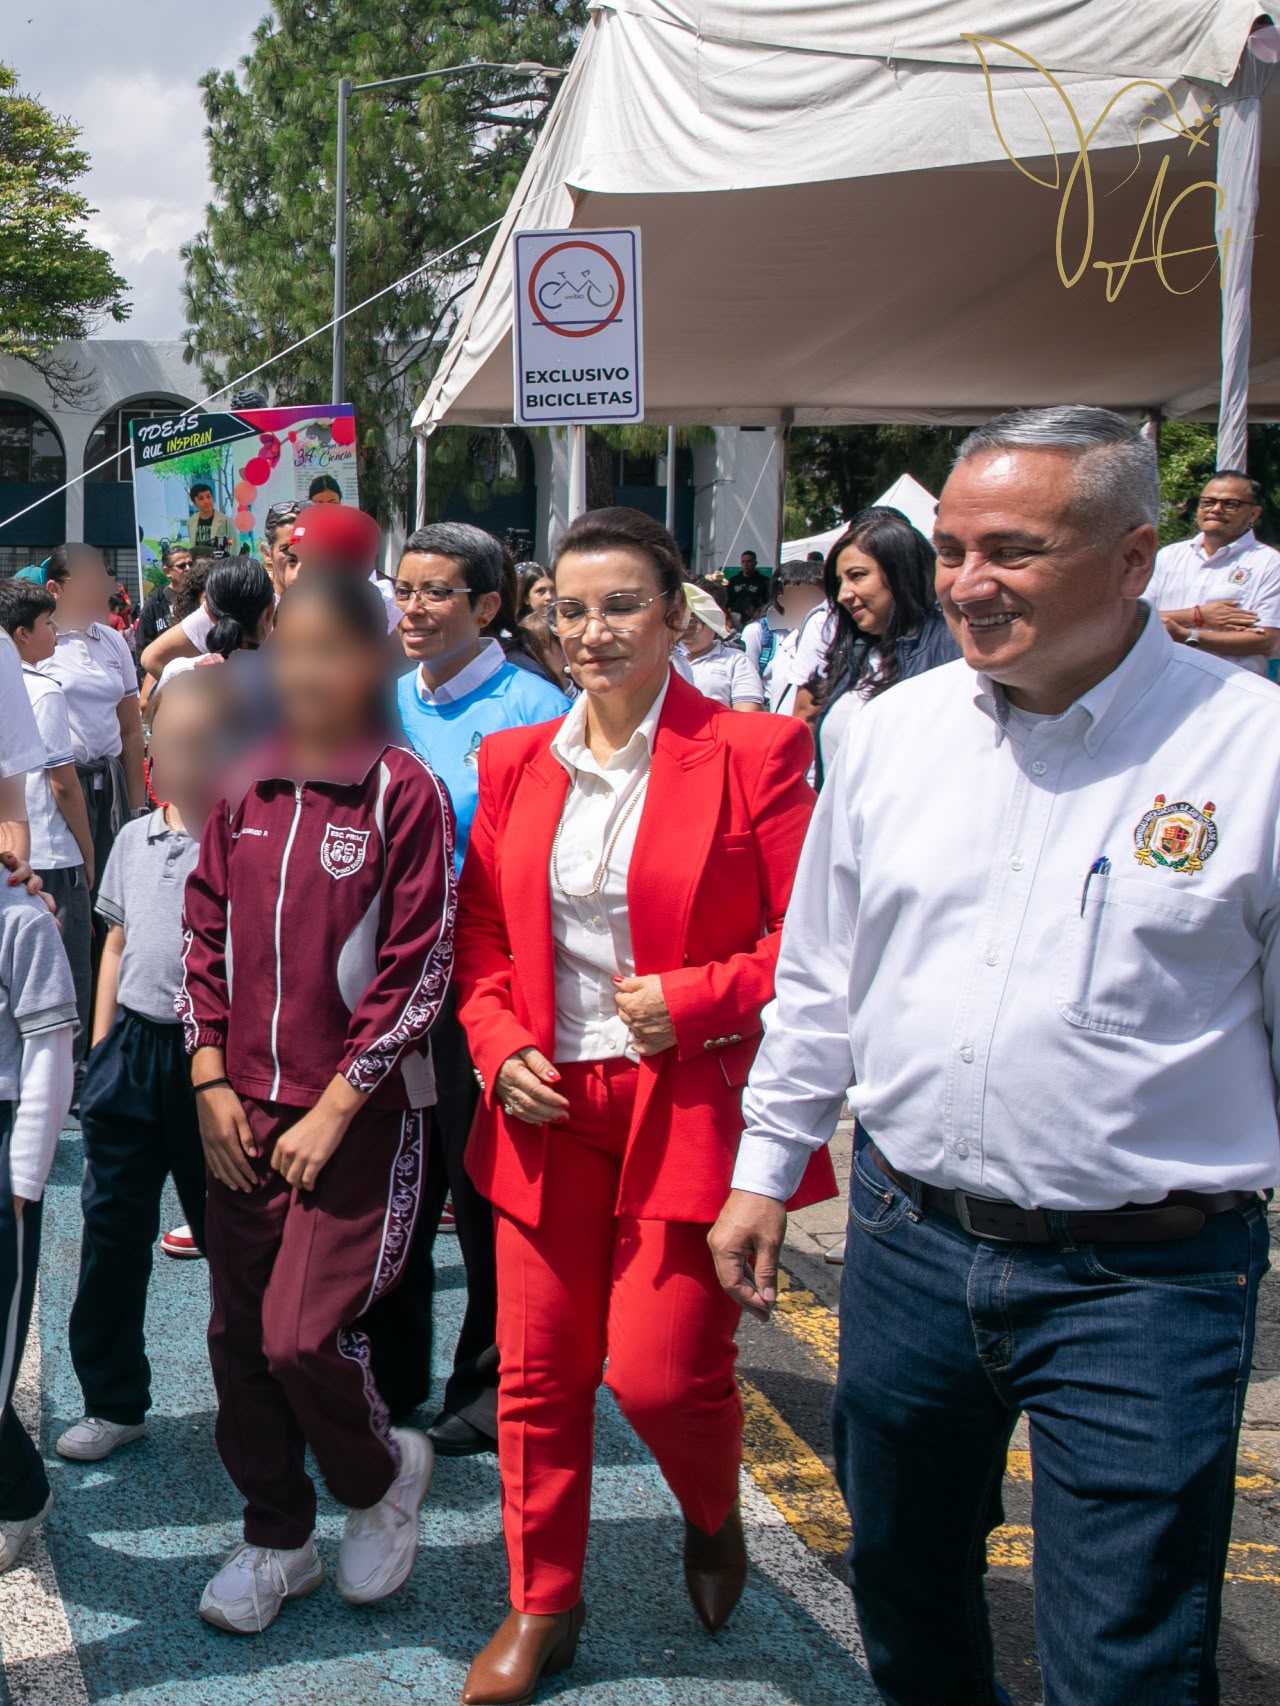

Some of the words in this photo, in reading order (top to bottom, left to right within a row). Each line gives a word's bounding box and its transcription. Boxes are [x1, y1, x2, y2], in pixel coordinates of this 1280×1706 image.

[525, 367, 629, 384] EXCLUSIVO
[526, 391, 633, 408] BICICLETAS
[138, 414, 199, 442] IDEAS
[142, 443, 163, 459] QUE
[166, 427, 212, 453] INSPIRAN
[319, 450, 352, 467] Ciencia
